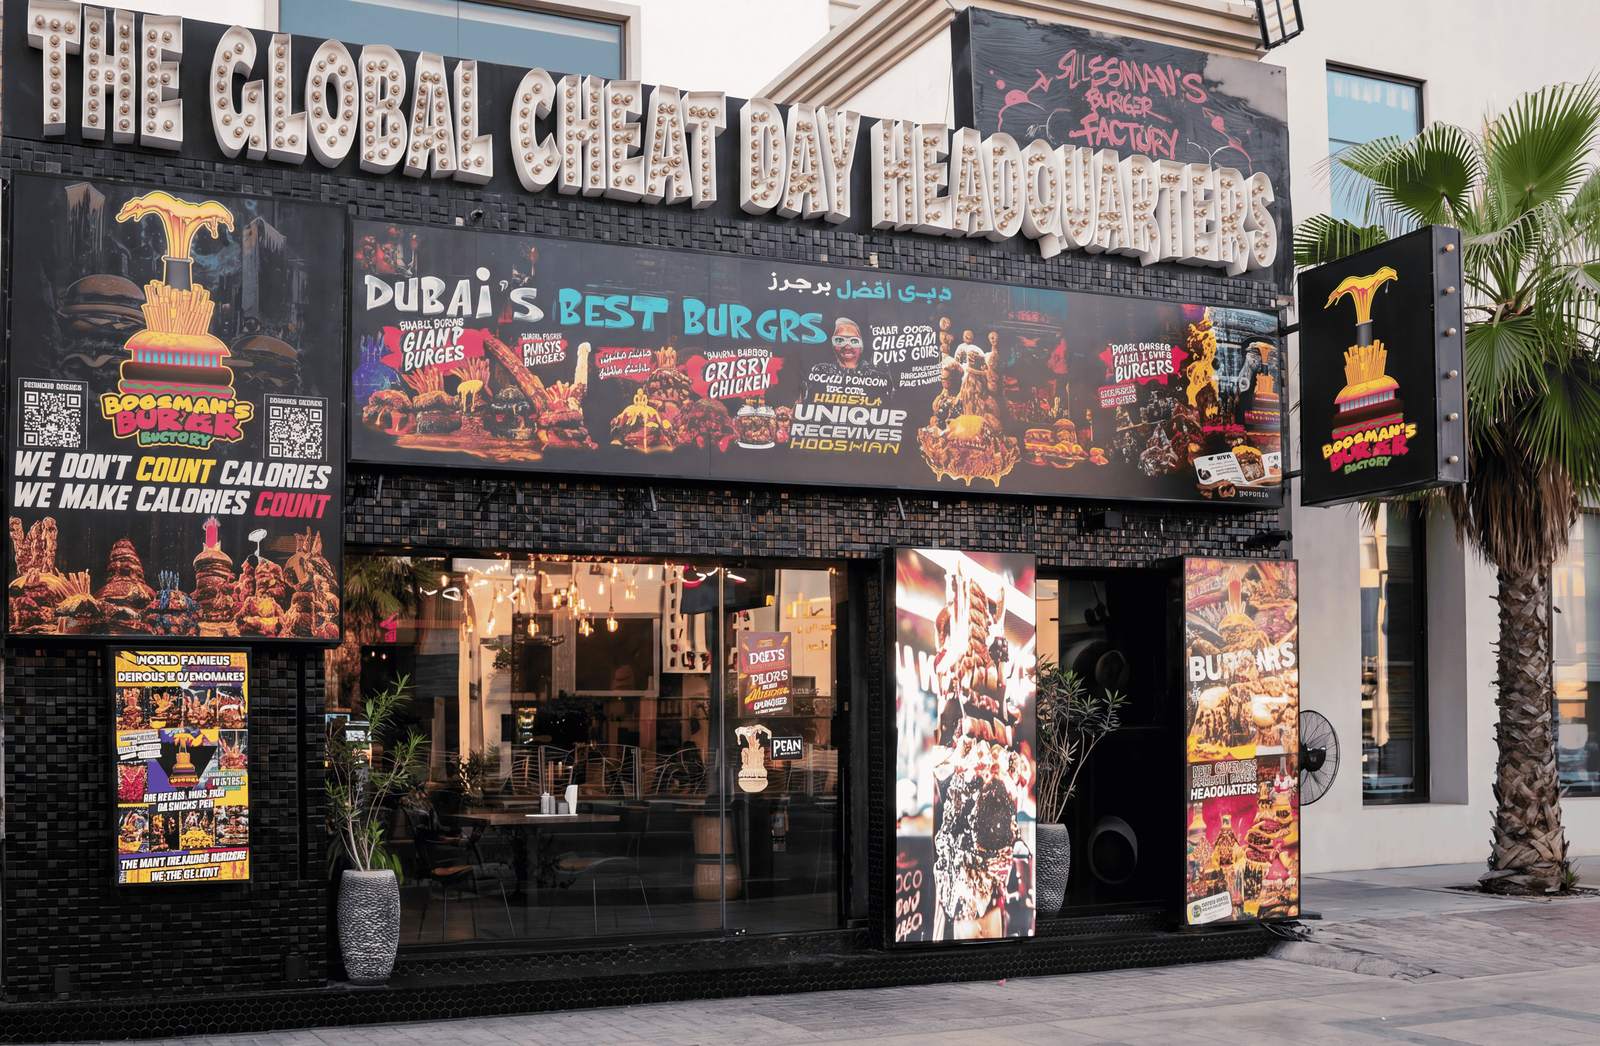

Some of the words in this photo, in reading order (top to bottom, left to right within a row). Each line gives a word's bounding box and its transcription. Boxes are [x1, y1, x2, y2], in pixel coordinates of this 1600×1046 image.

[27, 0, 183, 151] THE
[209, 25, 493, 184] GLOBAL
[510, 68, 727, 209] CHEAT
[740, 98, 861, 224] DAY
[871, 119, 1278, 277] HEADQUARTERS
[559, 288, 669, 332] BEST
[709, 373, 770, 399] CHICKEN
[1115, 360, 1174, 383] BURGERS
[14, 450, 56, 477] WE
[59, 452, 132, 481] DON'T
[135, 455, 217, 484] COUNT
[219, 460, 333, 490] CALORIES
[14, 481, 56, 508] WE
[58, 483, 133, 511] MAKE
[135, 486, 251, 516] CALORIES
[254, 491, 332, 519] COUNT
[773, 739, 801, 758] PEAN
[121, 860, 138, 870] THE
